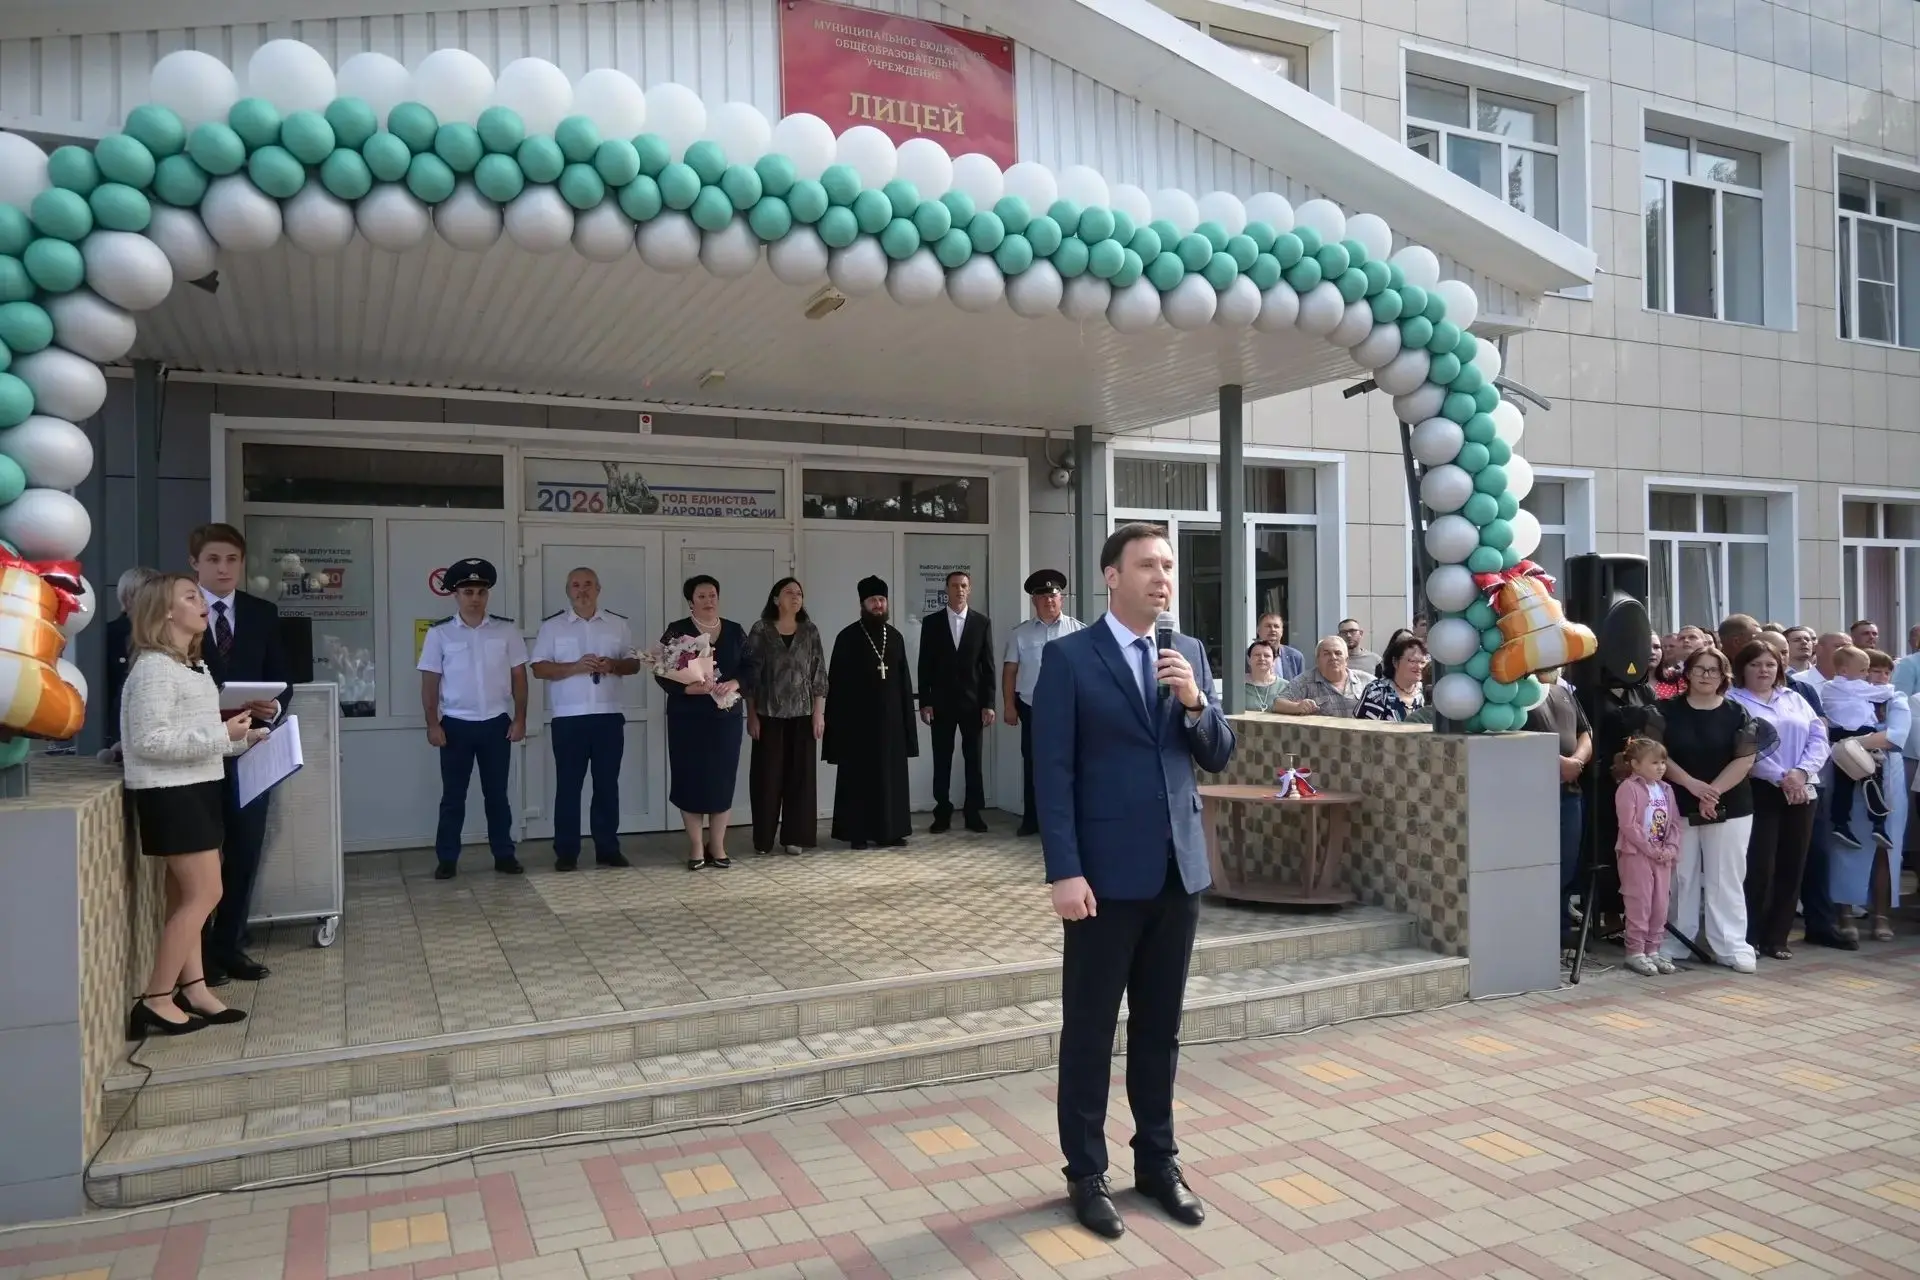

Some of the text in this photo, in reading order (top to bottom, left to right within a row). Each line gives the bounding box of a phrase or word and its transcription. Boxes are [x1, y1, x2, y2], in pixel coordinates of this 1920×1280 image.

[813, 19, 917, 47] МУНИЦИПАЛЬНОЕ
[866, 57, 942, 80] УЧРЕЖДЕНИЕ
[848, 92, 965, 135] ЛИЦЕЙ
[537, 489, 757, 513] 2026 ГОД ЕДИНСТВА
[662, 506, 776, 519] НАРОДОВ РОССИИ
[287, 584, 301, 595] 18
[939, 594, 949, 603] 19
